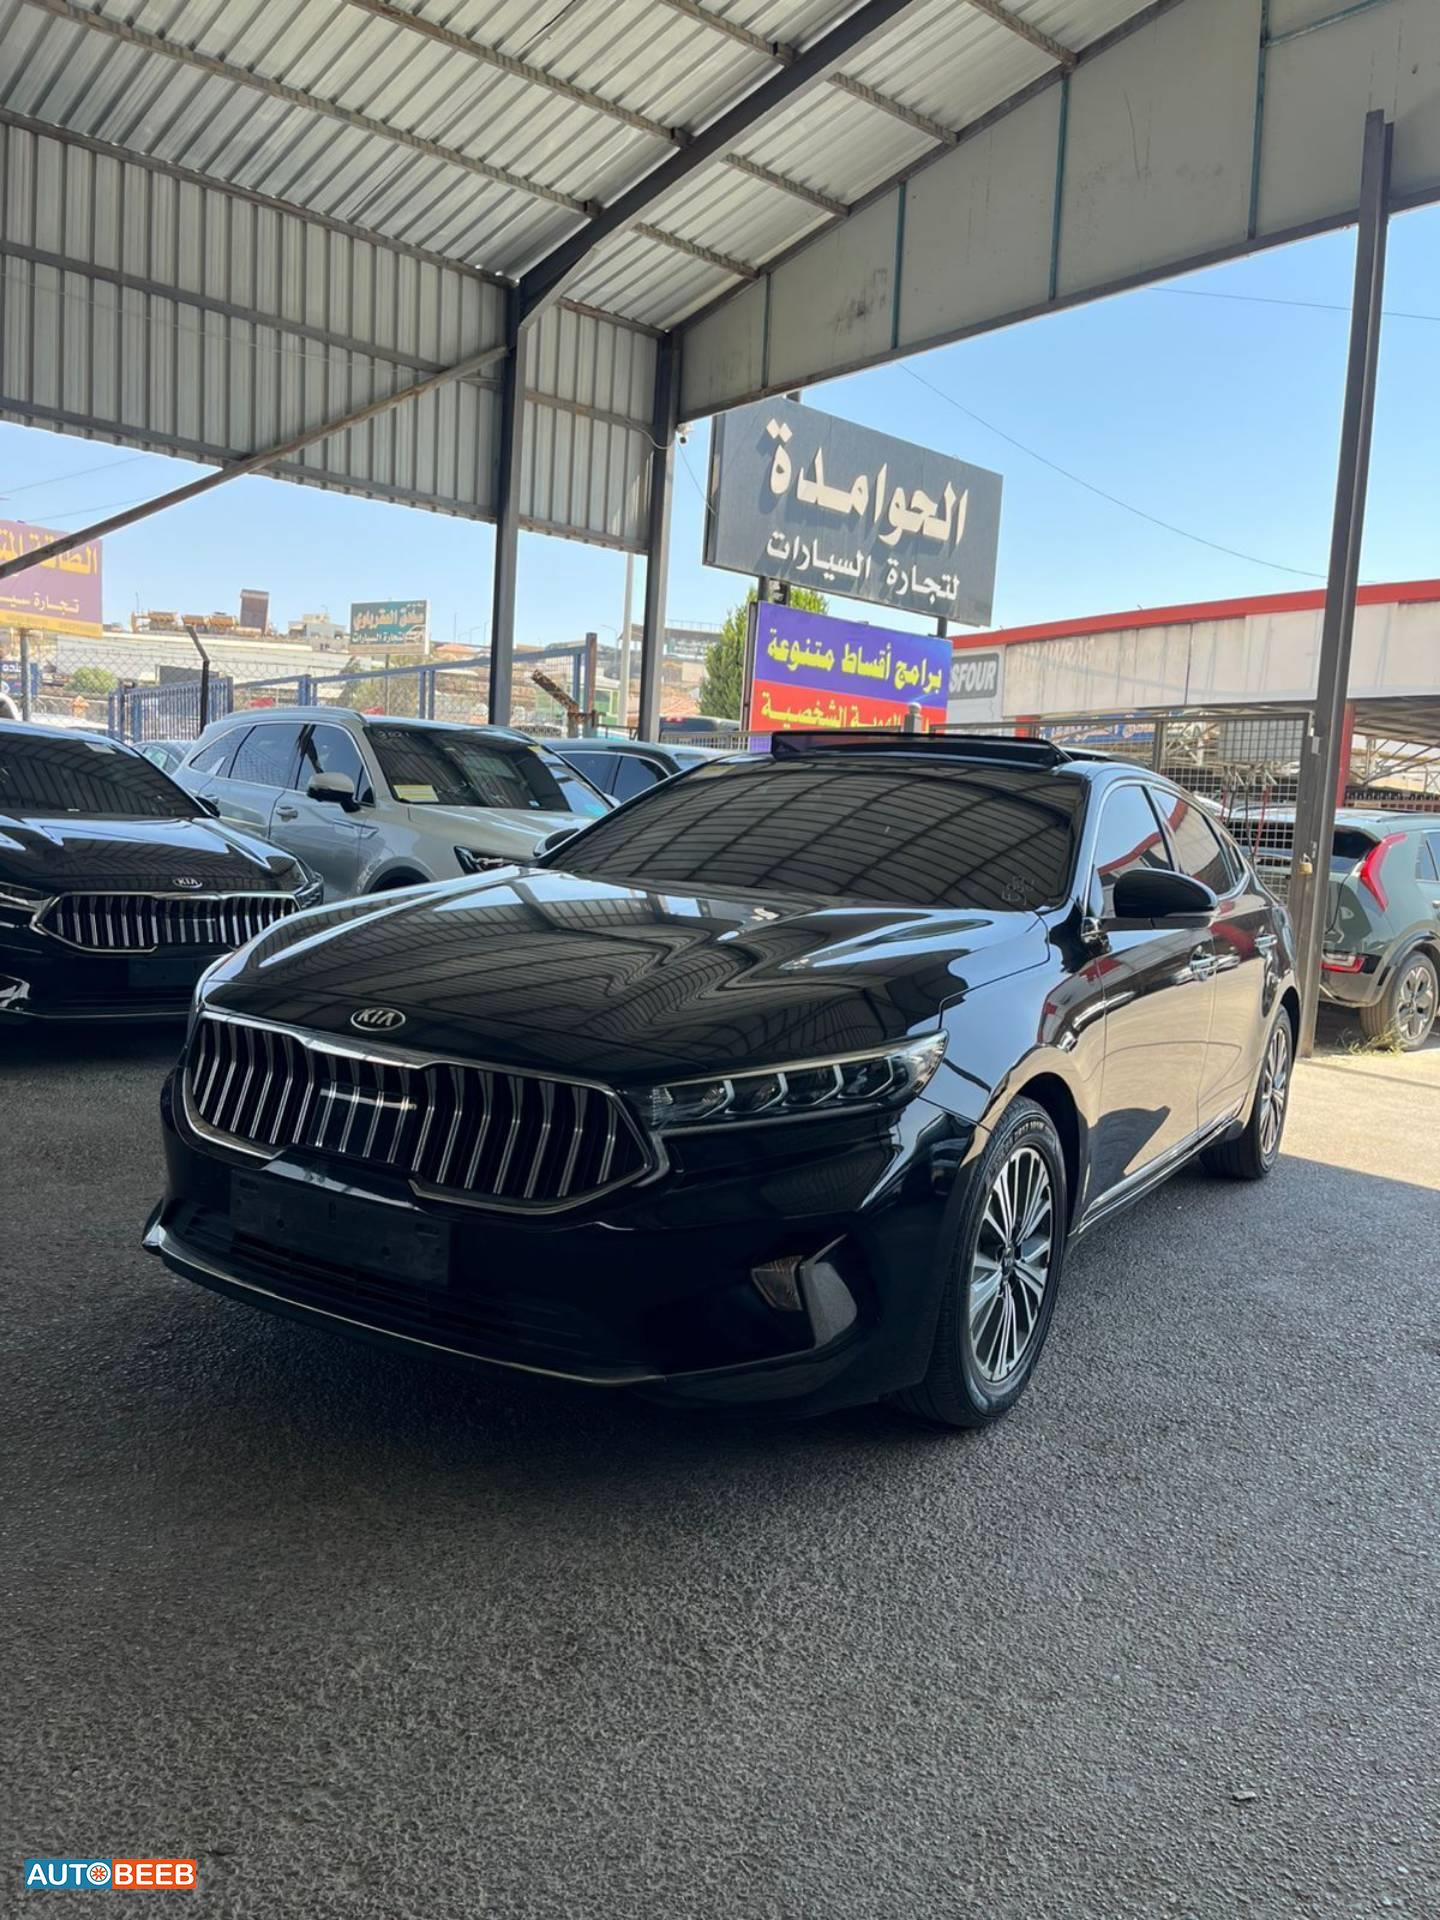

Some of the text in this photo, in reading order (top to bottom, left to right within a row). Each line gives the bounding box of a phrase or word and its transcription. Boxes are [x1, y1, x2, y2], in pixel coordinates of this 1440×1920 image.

[765, 418, 969, 546] الحوامدة
[766, 530, 960, 605] لتجارة السيارات
[33, 592, 80, 615] تجارة
[766, 628, 943, 694] برامج أقساط متنوعة
[760, 690, 848, 729] الشخصية
[356, 1008, 397, 1027] KIA
